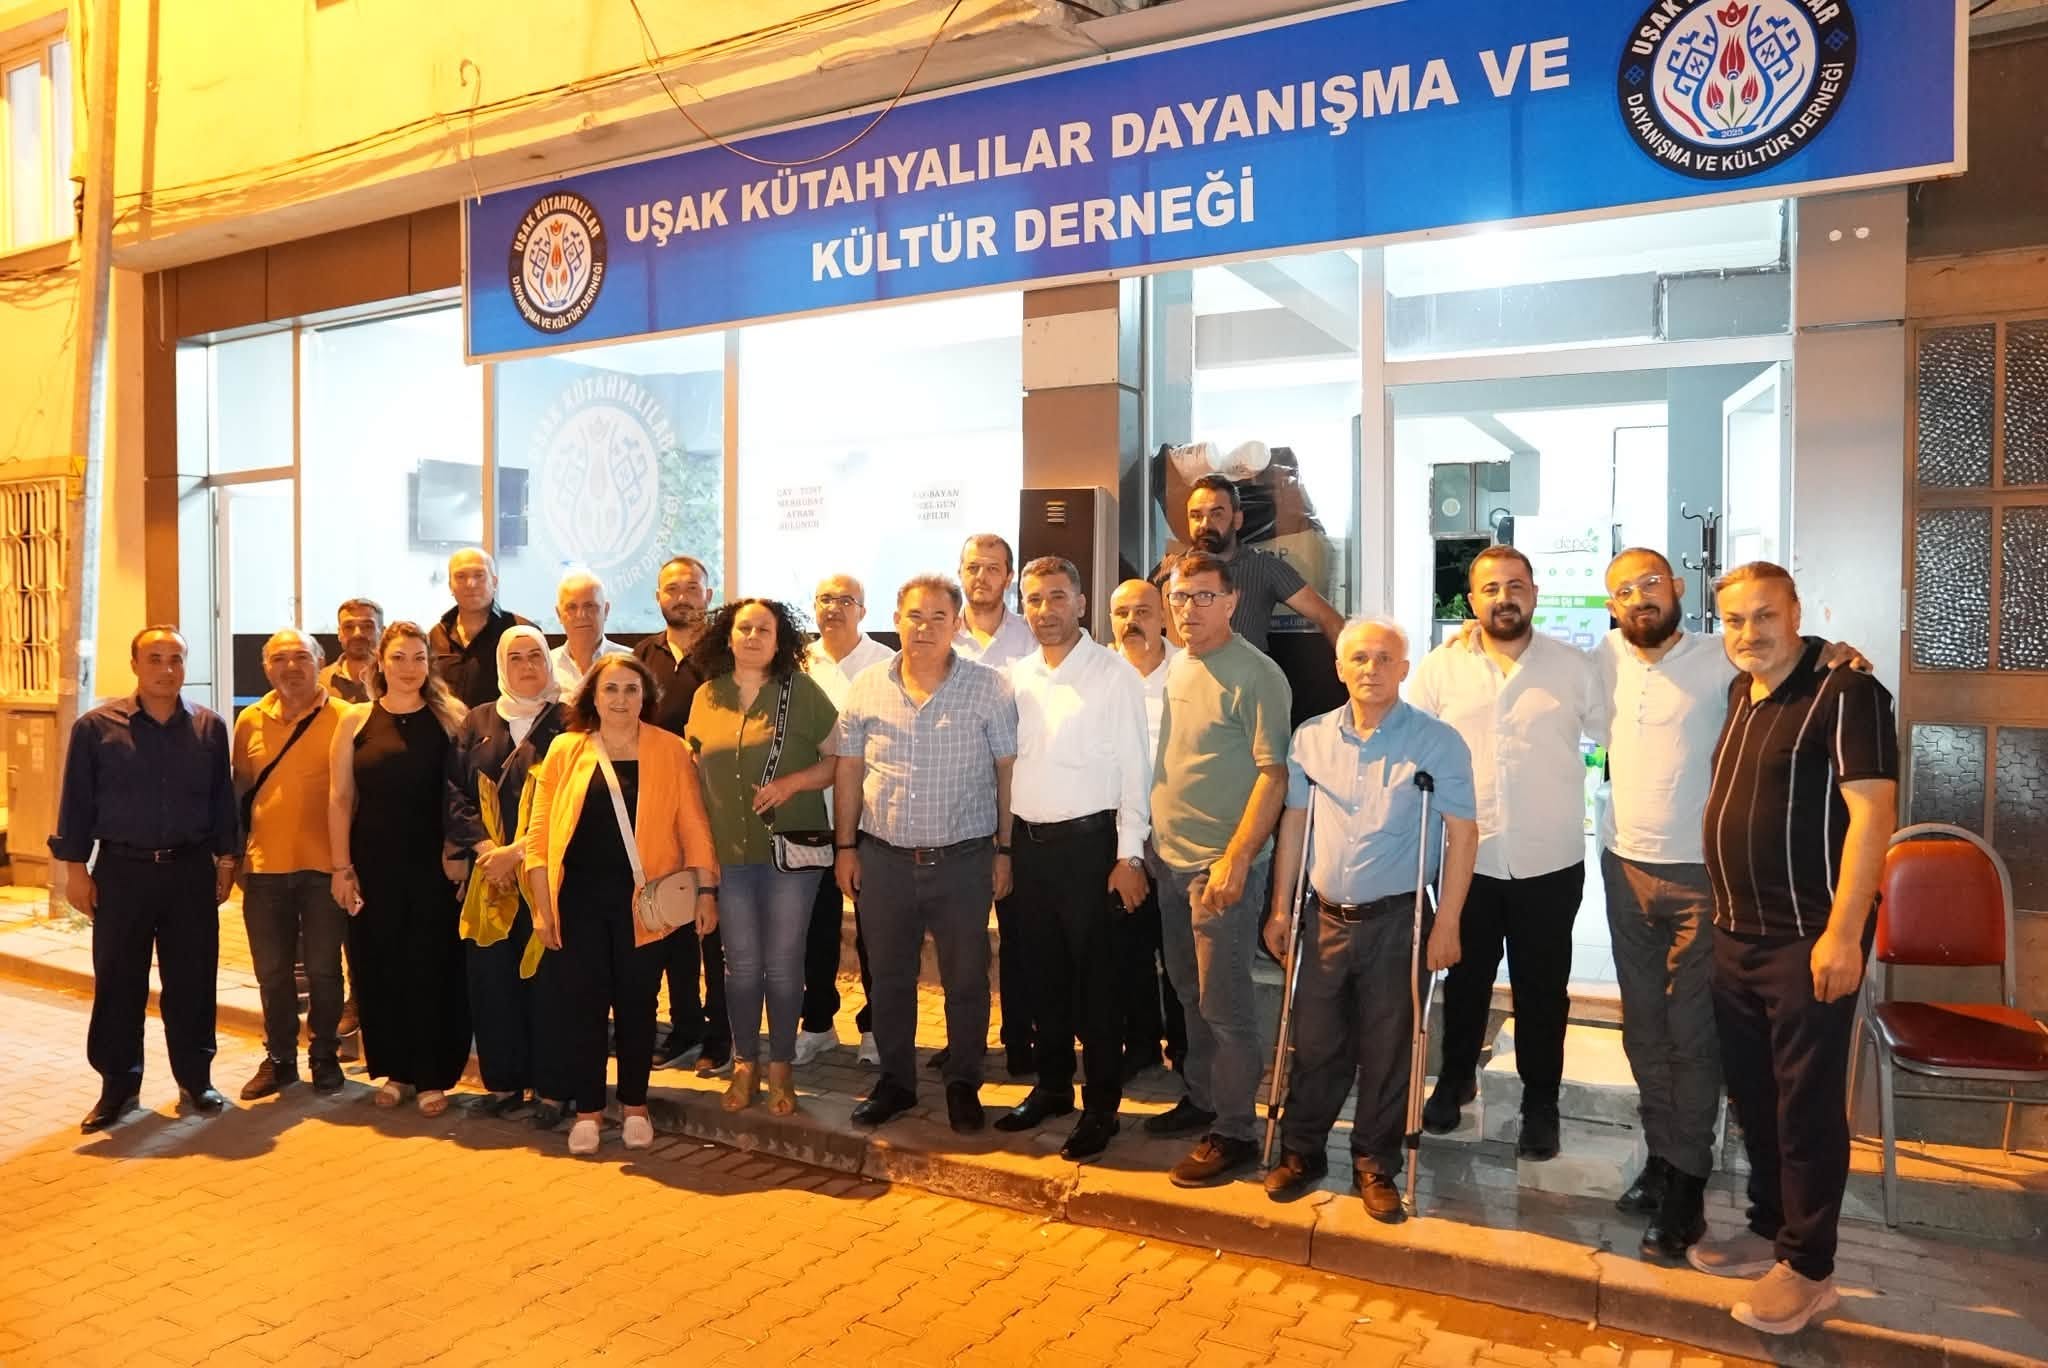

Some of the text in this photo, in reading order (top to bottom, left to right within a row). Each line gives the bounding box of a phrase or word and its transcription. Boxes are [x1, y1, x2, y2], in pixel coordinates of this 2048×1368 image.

[625, 36, 1571, 248] UŞAK KÜTAHYALILAR DAYANIŞMA VE
[1627, 61, 1845, 172] DAYANIŞMA VE KÜLTÜR DERNEĞİ
[534, 195, 601, 239] KÜTAHYALILAR
[811, 166, 1255, 282] KÜLTÜR DERNEĞİ
[512, 275, 541, 326] DAYANIŞMA
[541, 317, 552, 329] VE
[552, 304, 584, 329] KÜLTÜR
